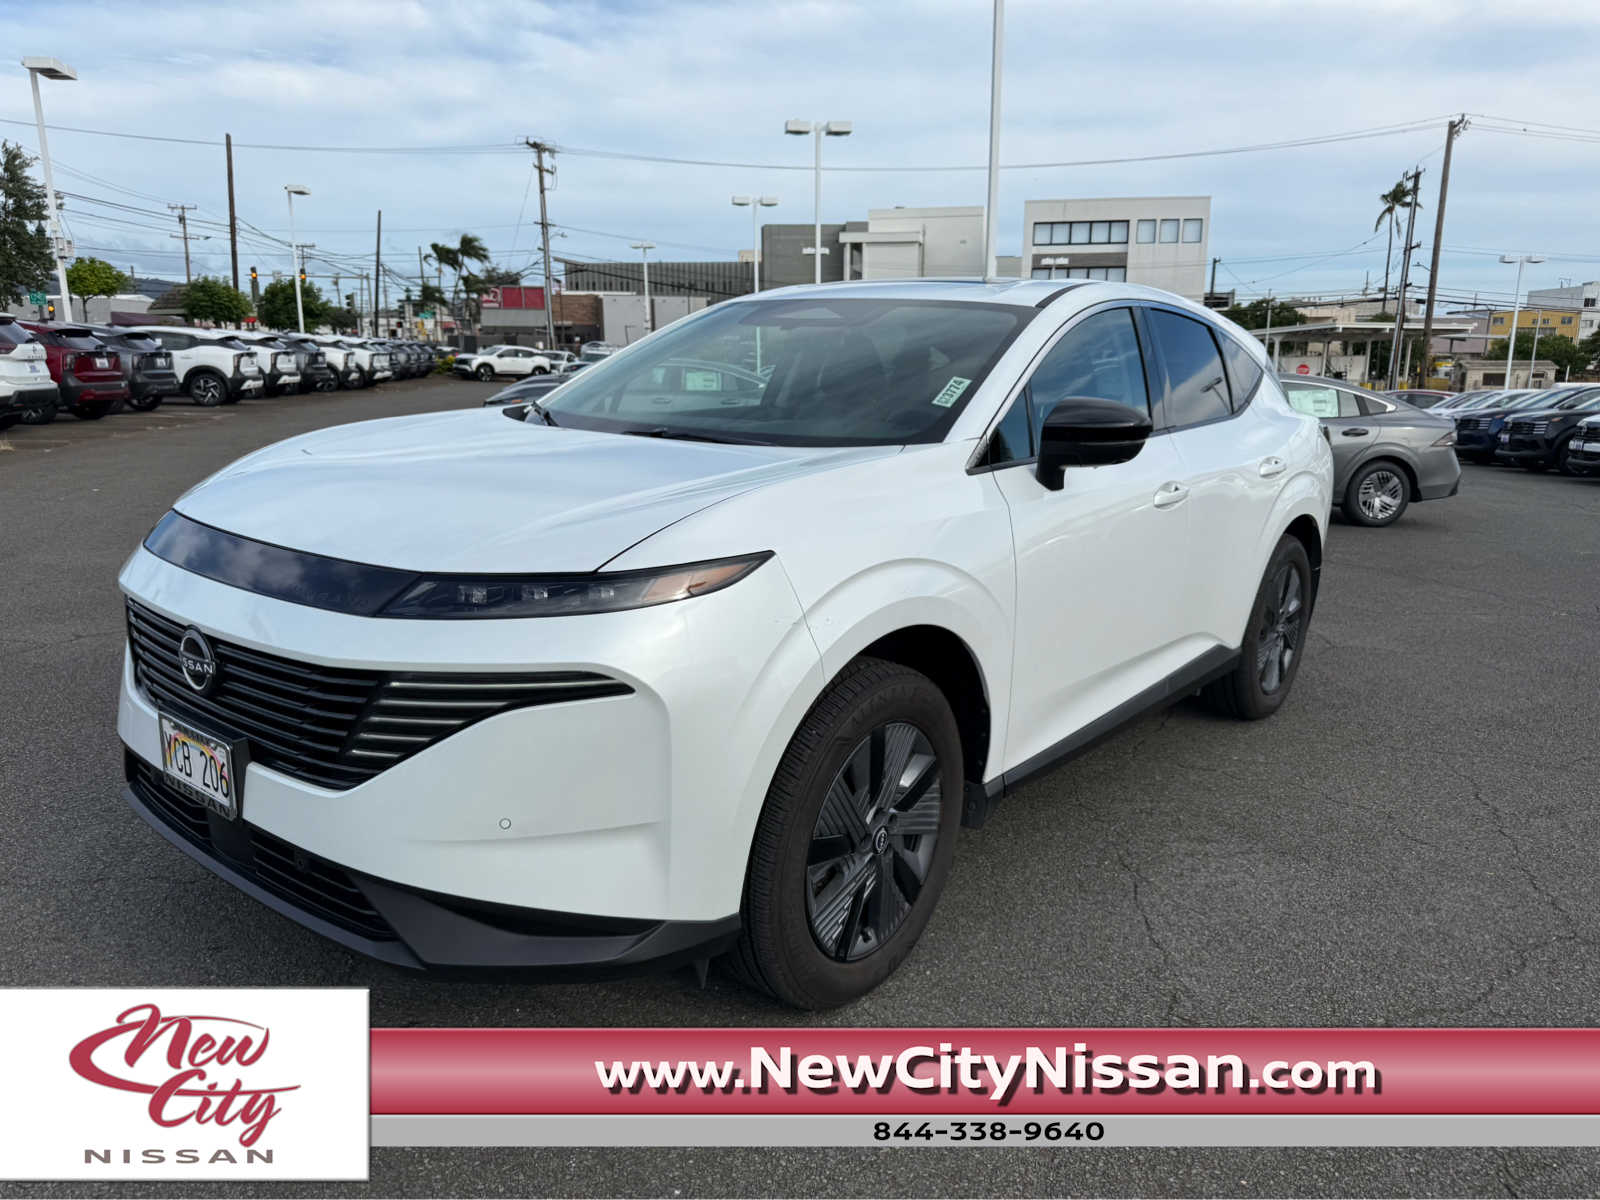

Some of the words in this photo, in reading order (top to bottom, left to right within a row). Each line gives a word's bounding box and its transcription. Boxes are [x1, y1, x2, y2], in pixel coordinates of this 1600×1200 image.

[179, 654, 214, 674] SSAN
[164, 731, 193, 777] YCB
[200, 748, 230, 798] 206
